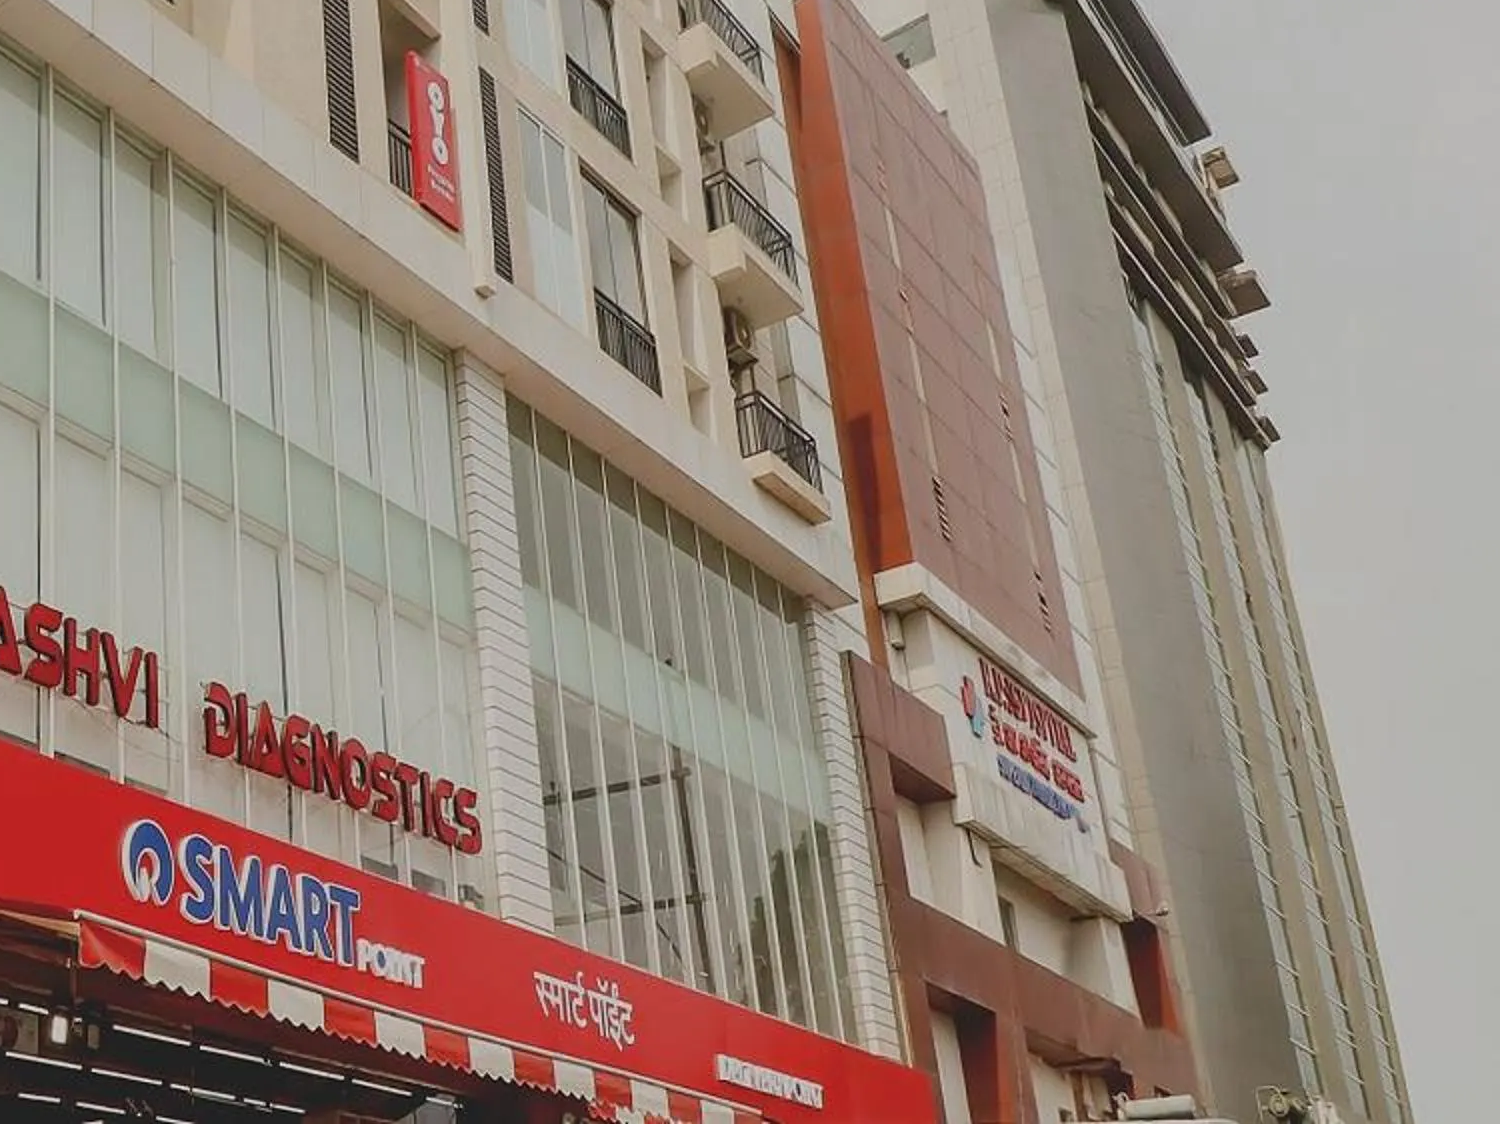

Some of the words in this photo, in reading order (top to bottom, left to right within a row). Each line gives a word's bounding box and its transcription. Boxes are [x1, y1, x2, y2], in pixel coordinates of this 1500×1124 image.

[202, 680, 483, 855] DIAGNOSTICS
[178, 833, 361, 967] SMART
[357, 938, 426, 989] POINT
[533, 971, 588, 1029] स्मार्ट
